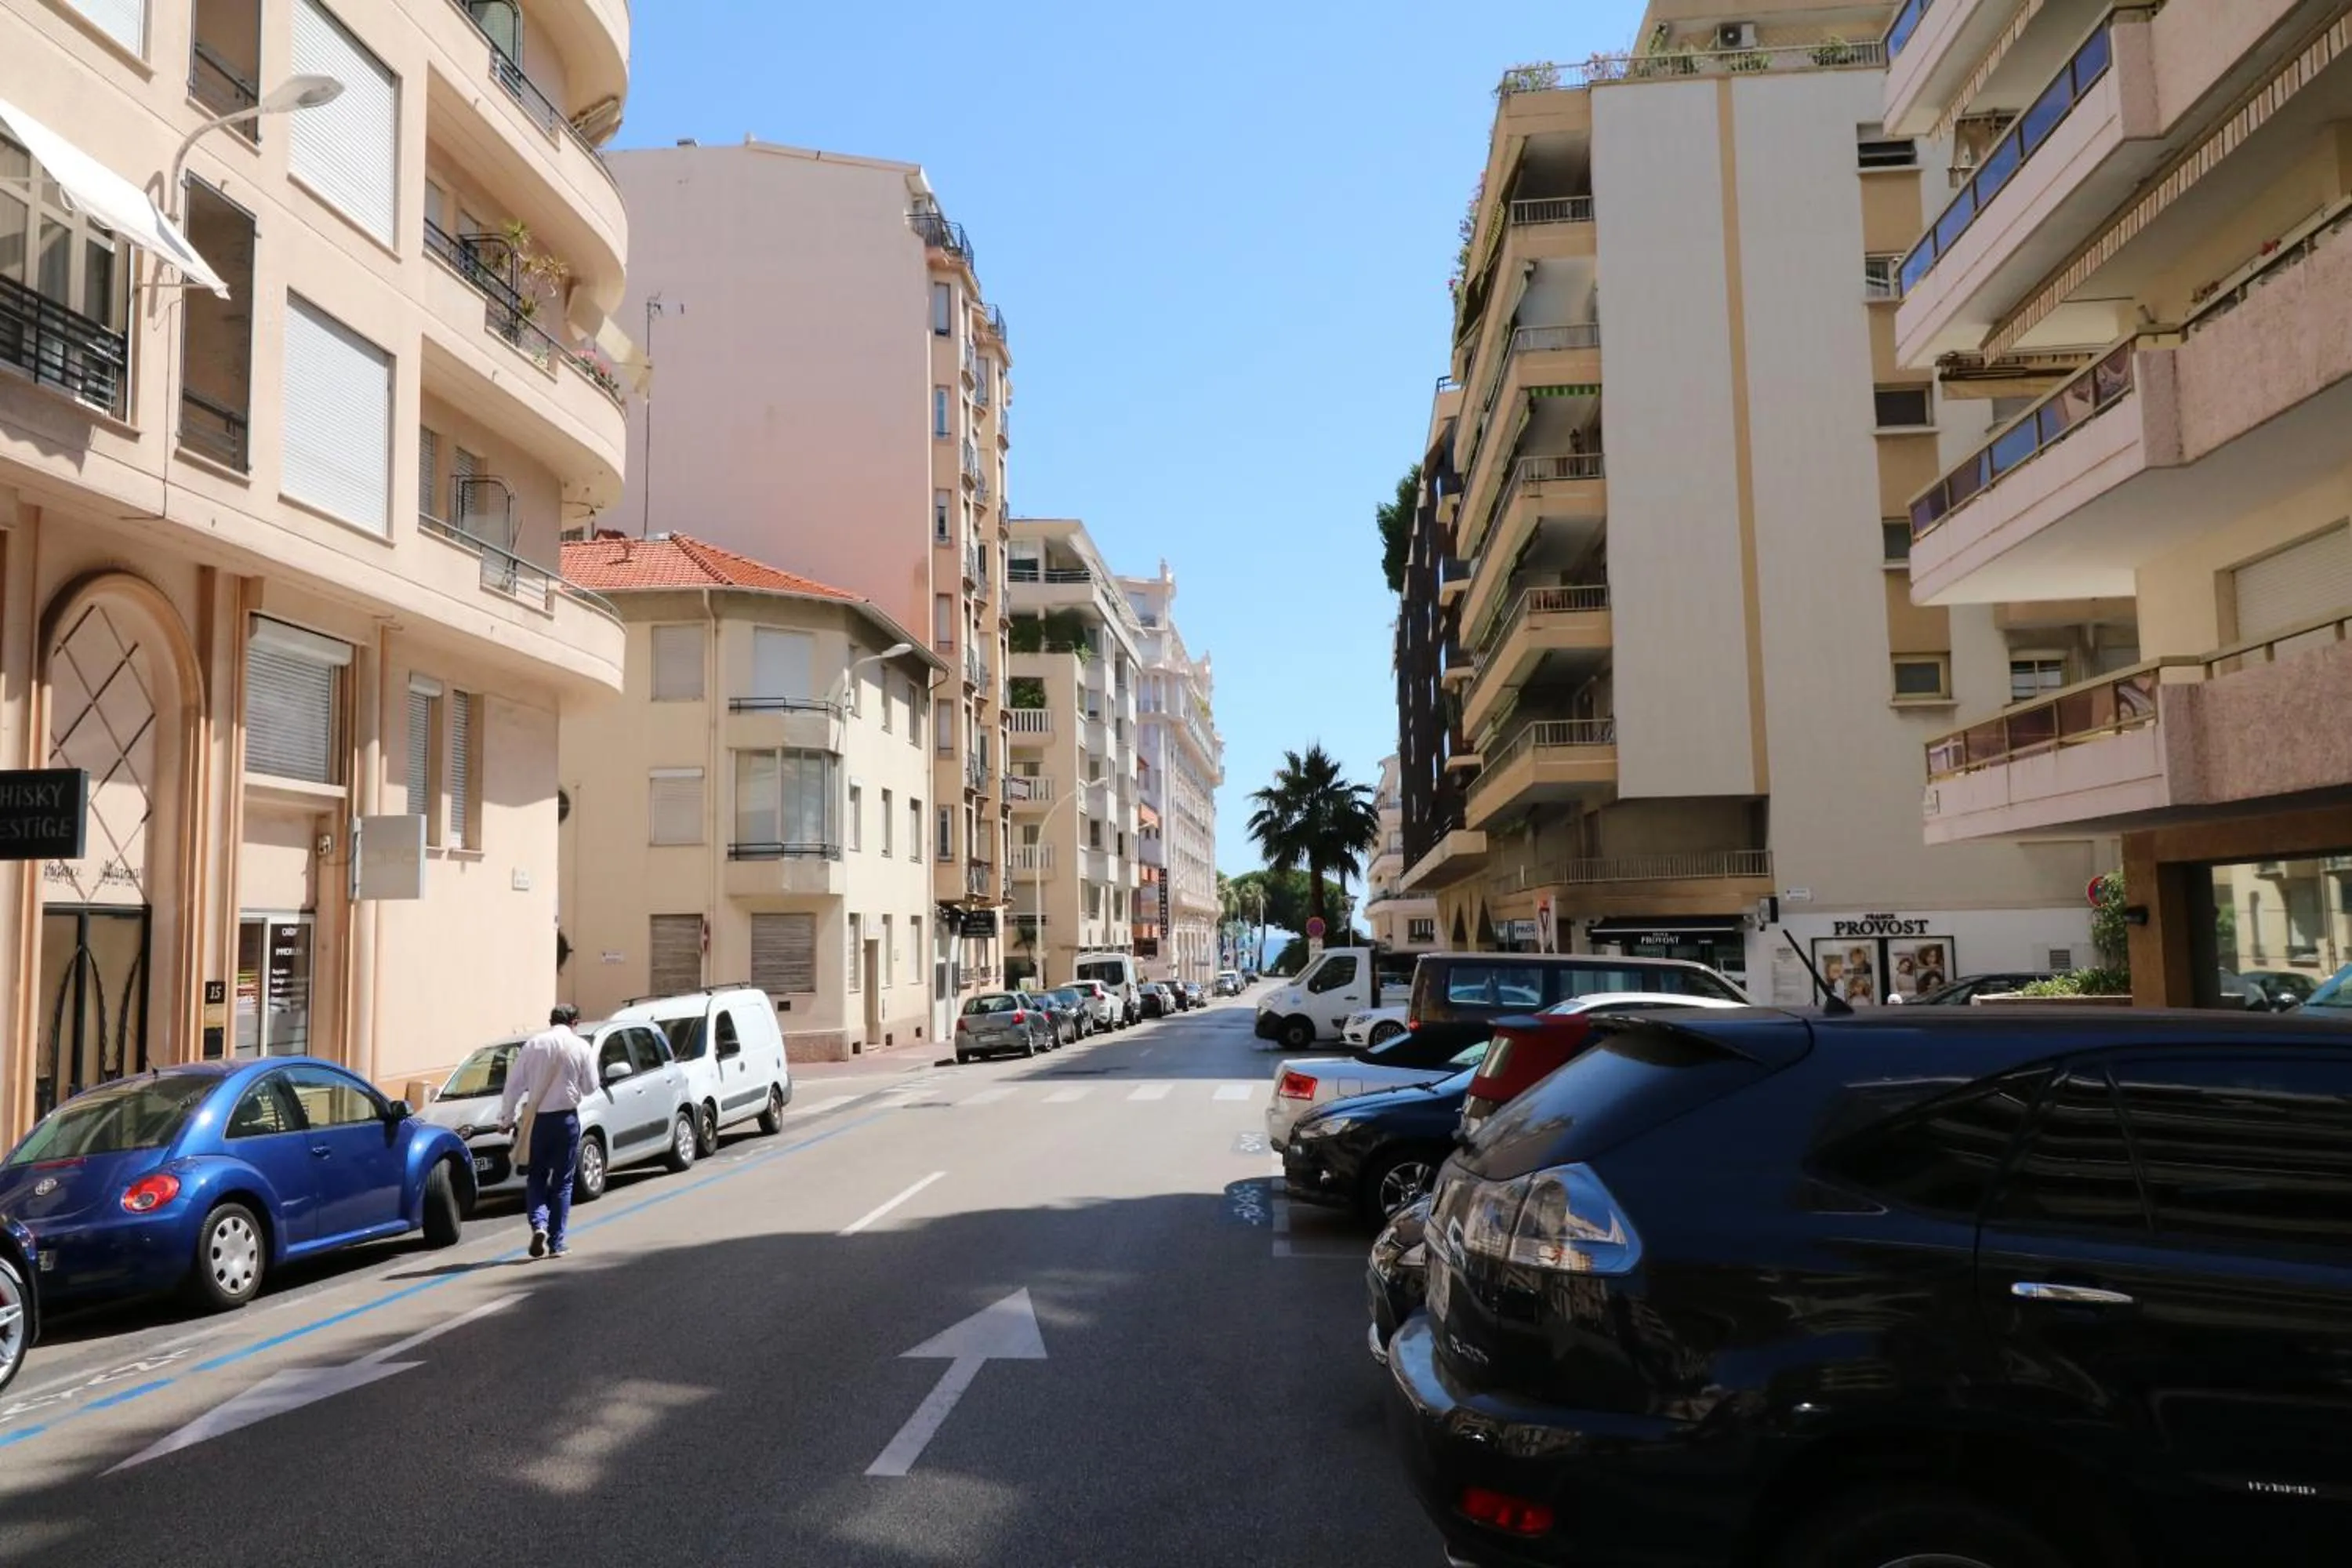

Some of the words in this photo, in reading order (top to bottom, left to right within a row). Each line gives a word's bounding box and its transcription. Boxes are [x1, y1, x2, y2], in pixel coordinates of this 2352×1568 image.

[1833, 920, 1929, 936] PROVOST
[1641, 936, 1679, 945] PROVOST
[209, 985, 222, 1000] 15
[2248, 1481, 2316, 1495] HYBRID
